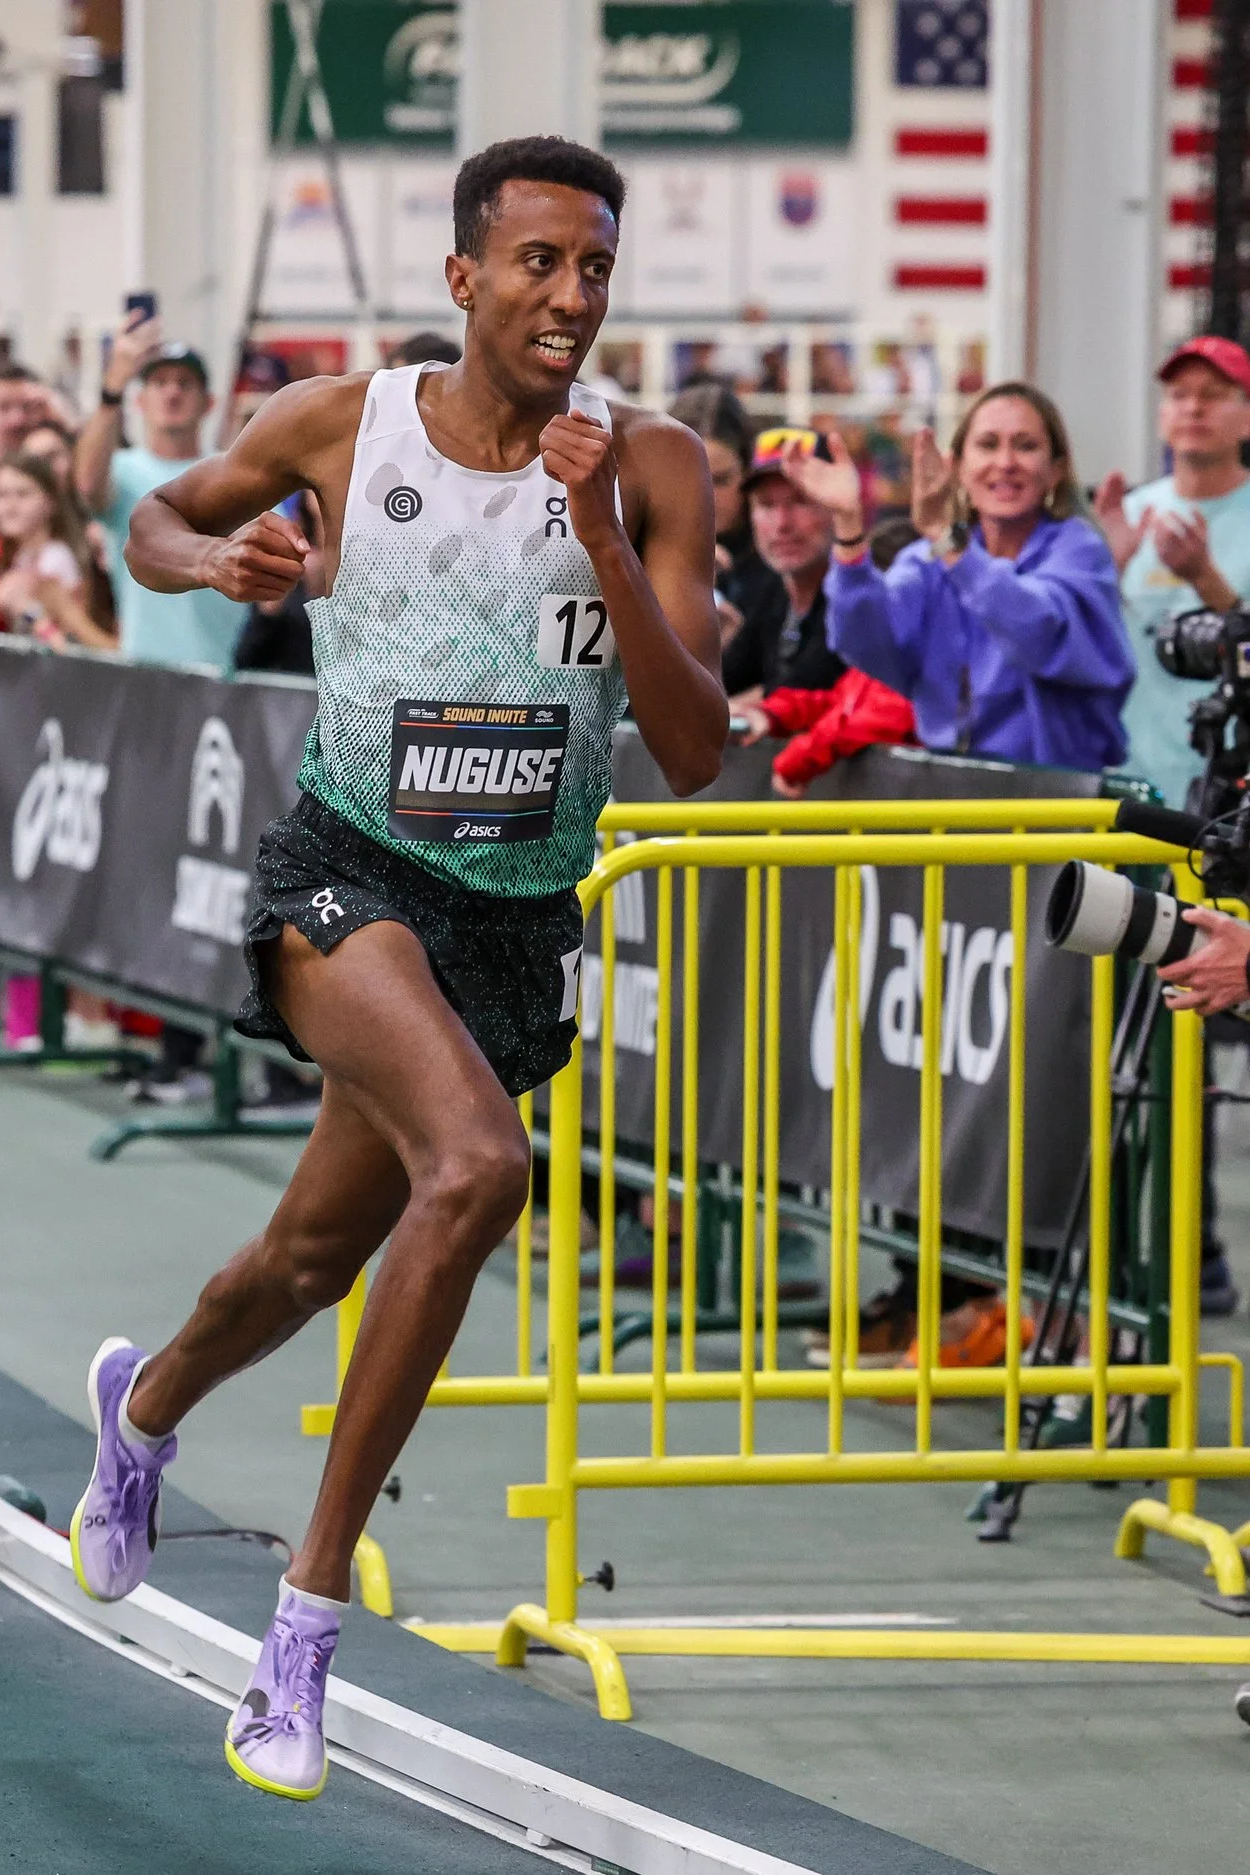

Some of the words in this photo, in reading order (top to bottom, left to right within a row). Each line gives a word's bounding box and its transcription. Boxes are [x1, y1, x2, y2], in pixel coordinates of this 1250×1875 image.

[555, 600, 609, 665] 12
[442, 707, 485, 722] SOUND
[486, 709, 528, 724] INVITE
[398, 745, 564, 794] NUGUSE
[469, 825, 501, 837] asics
